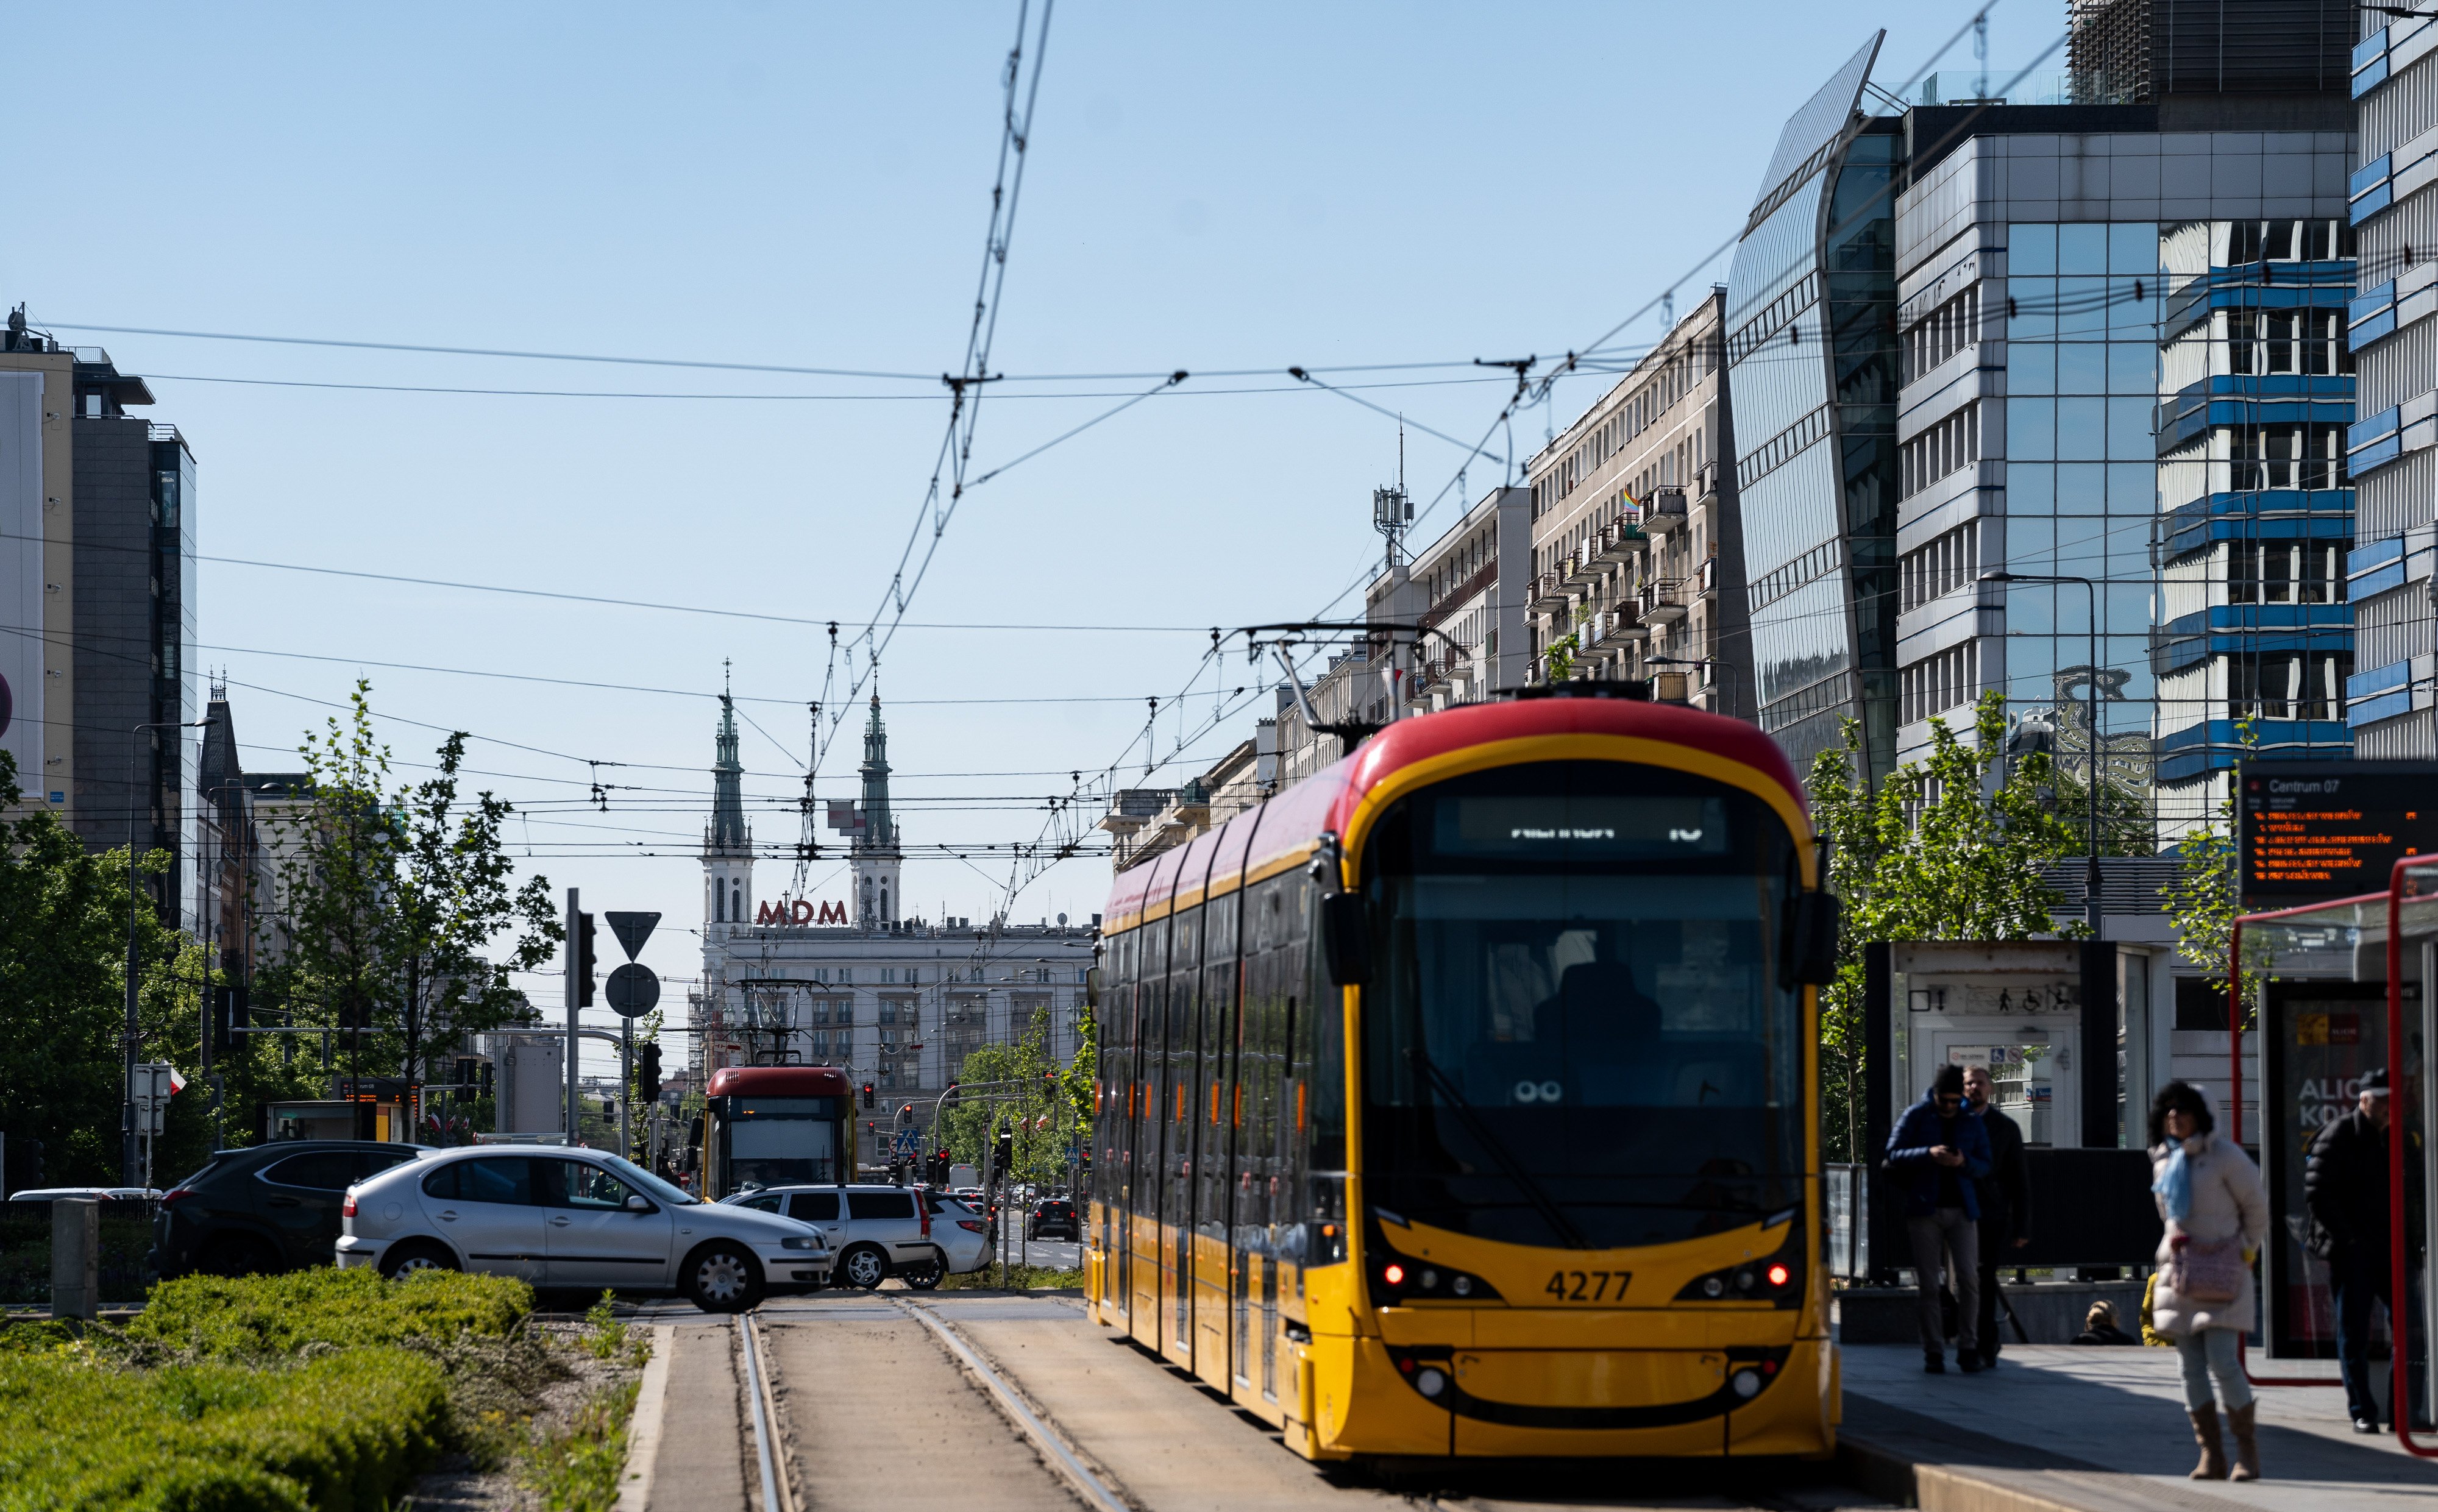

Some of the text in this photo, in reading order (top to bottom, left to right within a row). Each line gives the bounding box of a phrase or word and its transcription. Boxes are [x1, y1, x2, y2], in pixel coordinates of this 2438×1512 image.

[2269, 779, 2340, 792] Centrum 07
[756, 900, 848, 925] MDM
[2298, 1079, 2361, 1100] ALIO
[1545, 1271, 1632, 1301] 4277
